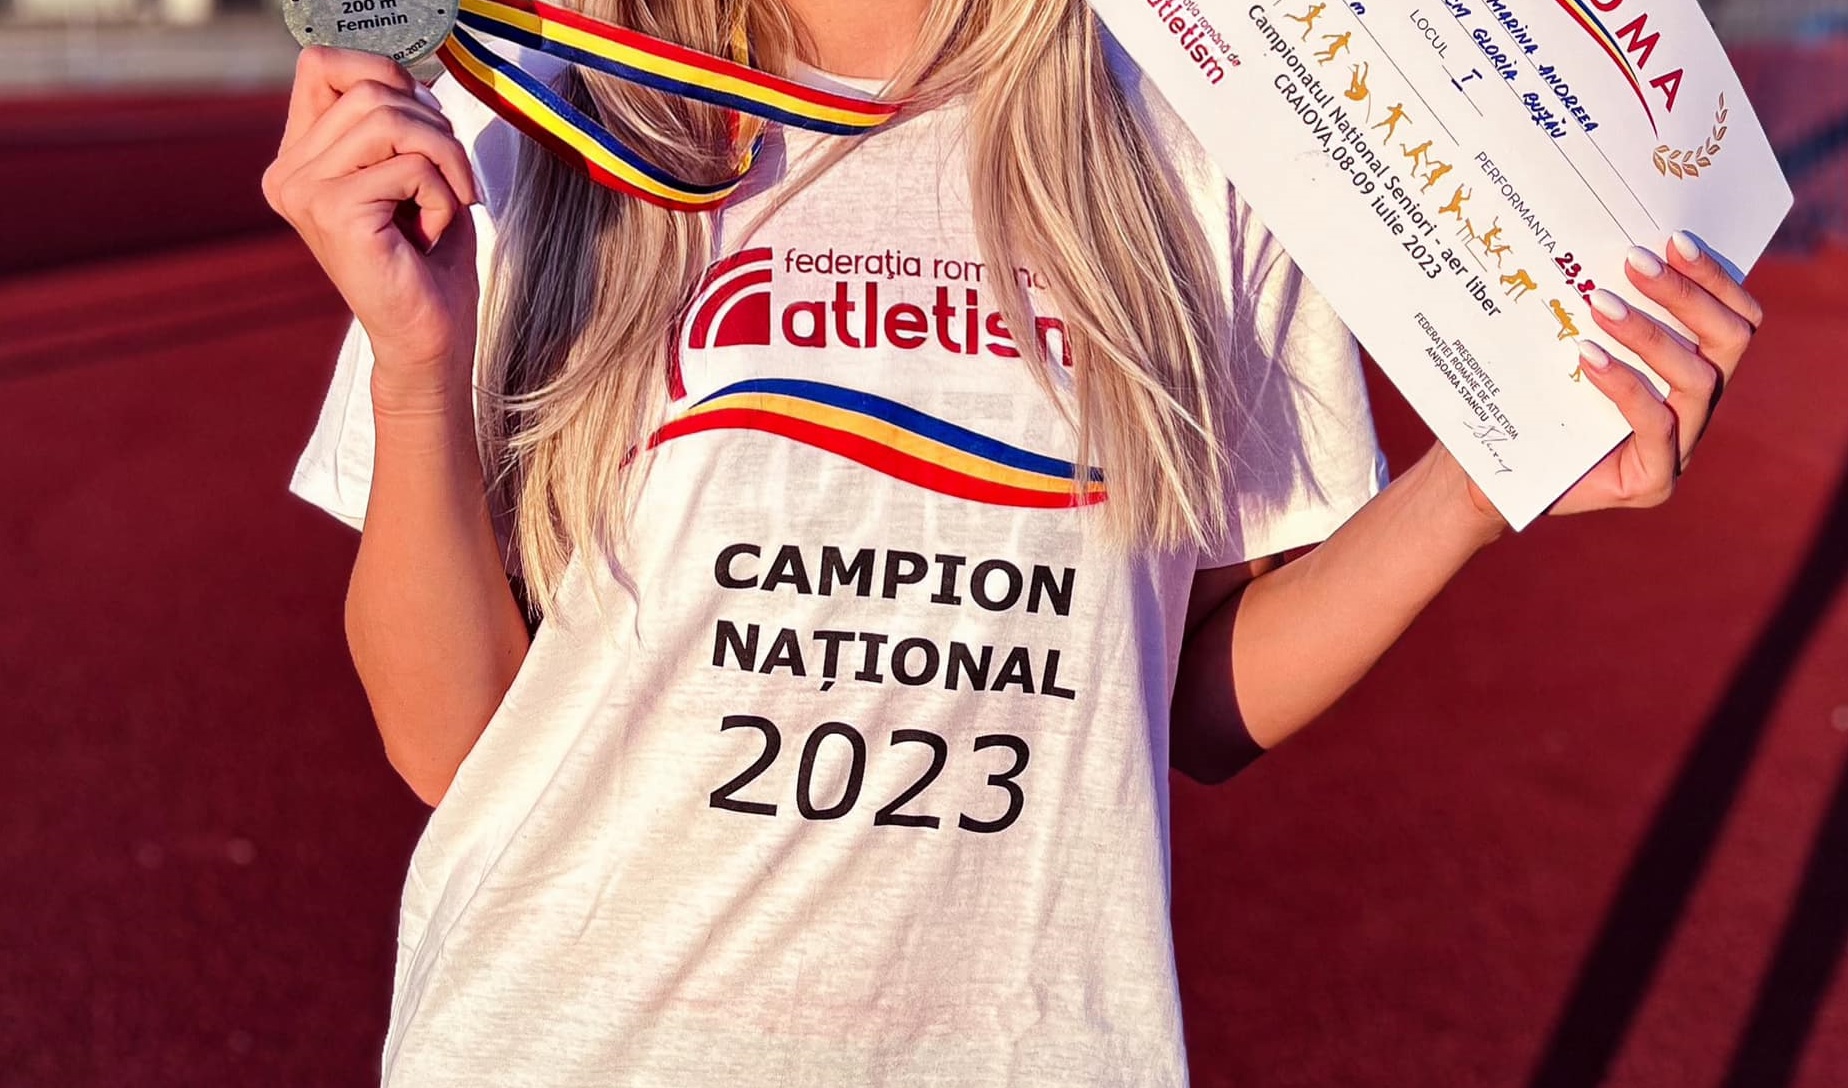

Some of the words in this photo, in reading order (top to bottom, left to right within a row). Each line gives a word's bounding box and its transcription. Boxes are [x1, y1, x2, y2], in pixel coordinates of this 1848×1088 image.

[336, 12, 408, 32] Feminin
[386, 38, 427, 61] 07.2023
[1409, 9, 1448, 60] LOCUL
[1471, 27, 1518, 81] GLORIA
[1537, 63, 1599, 132] ANDREEA
[1248, 4, 1335, 110] Campionatul
[1328, 105, 1391, 179] Național
[1383, 175, 1438, 238] Seniori
[1440, 248, 1469, 277] aer
[1465, 275, 1502, 318] liber
[1370, 195, 1405, 237] iulie
[1401, 234, 1443, 280] 2023
[1553, 251, 1596, 306] 23,8
[1457, 386, 1490, 423] STANCIU
[1476, 389, 1491, 405] DE
[1485, 402, 1519, 441] ATLETISM
[713, 542, 1077, 617] CAMPION
[711, 619, 1077, 701] NAȚIONAL
[708, 714, 1031, 835] 2023
